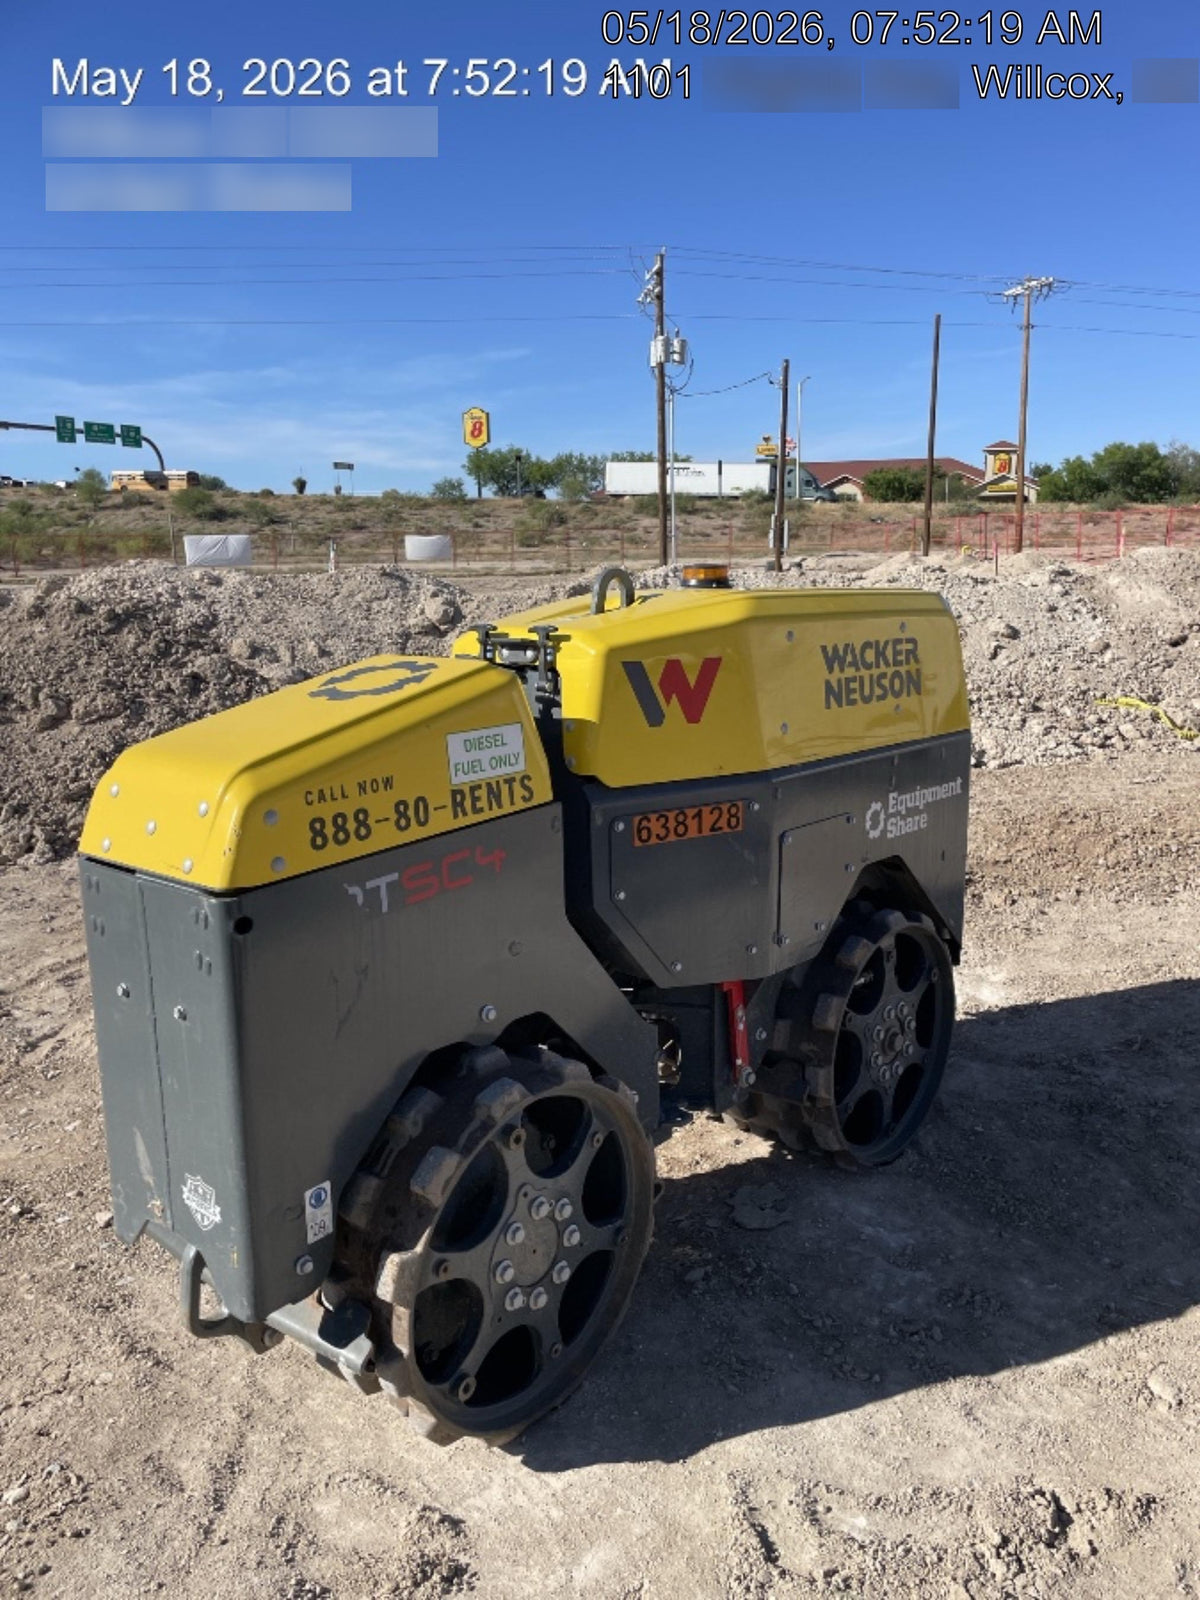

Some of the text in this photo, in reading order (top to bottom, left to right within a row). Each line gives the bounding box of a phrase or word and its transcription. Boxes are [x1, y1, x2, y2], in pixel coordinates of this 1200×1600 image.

[471, 421, 483, 438] 8
[820, 637, 920, 675] WACKER
[824, 668, 922, 710] NEUSON
[463, 733, 508, 753] DIESEL
[454, 752, 521, 777] FUEL ONLY
[304, 775, 394, 806] CALL NOW
[888, 777, 963, 814] Equipment
[308, 774, 534, 850] 888-80-RENTS
[635, 803, 741, 844] 638128
[886, 812, 928, 838] Share
